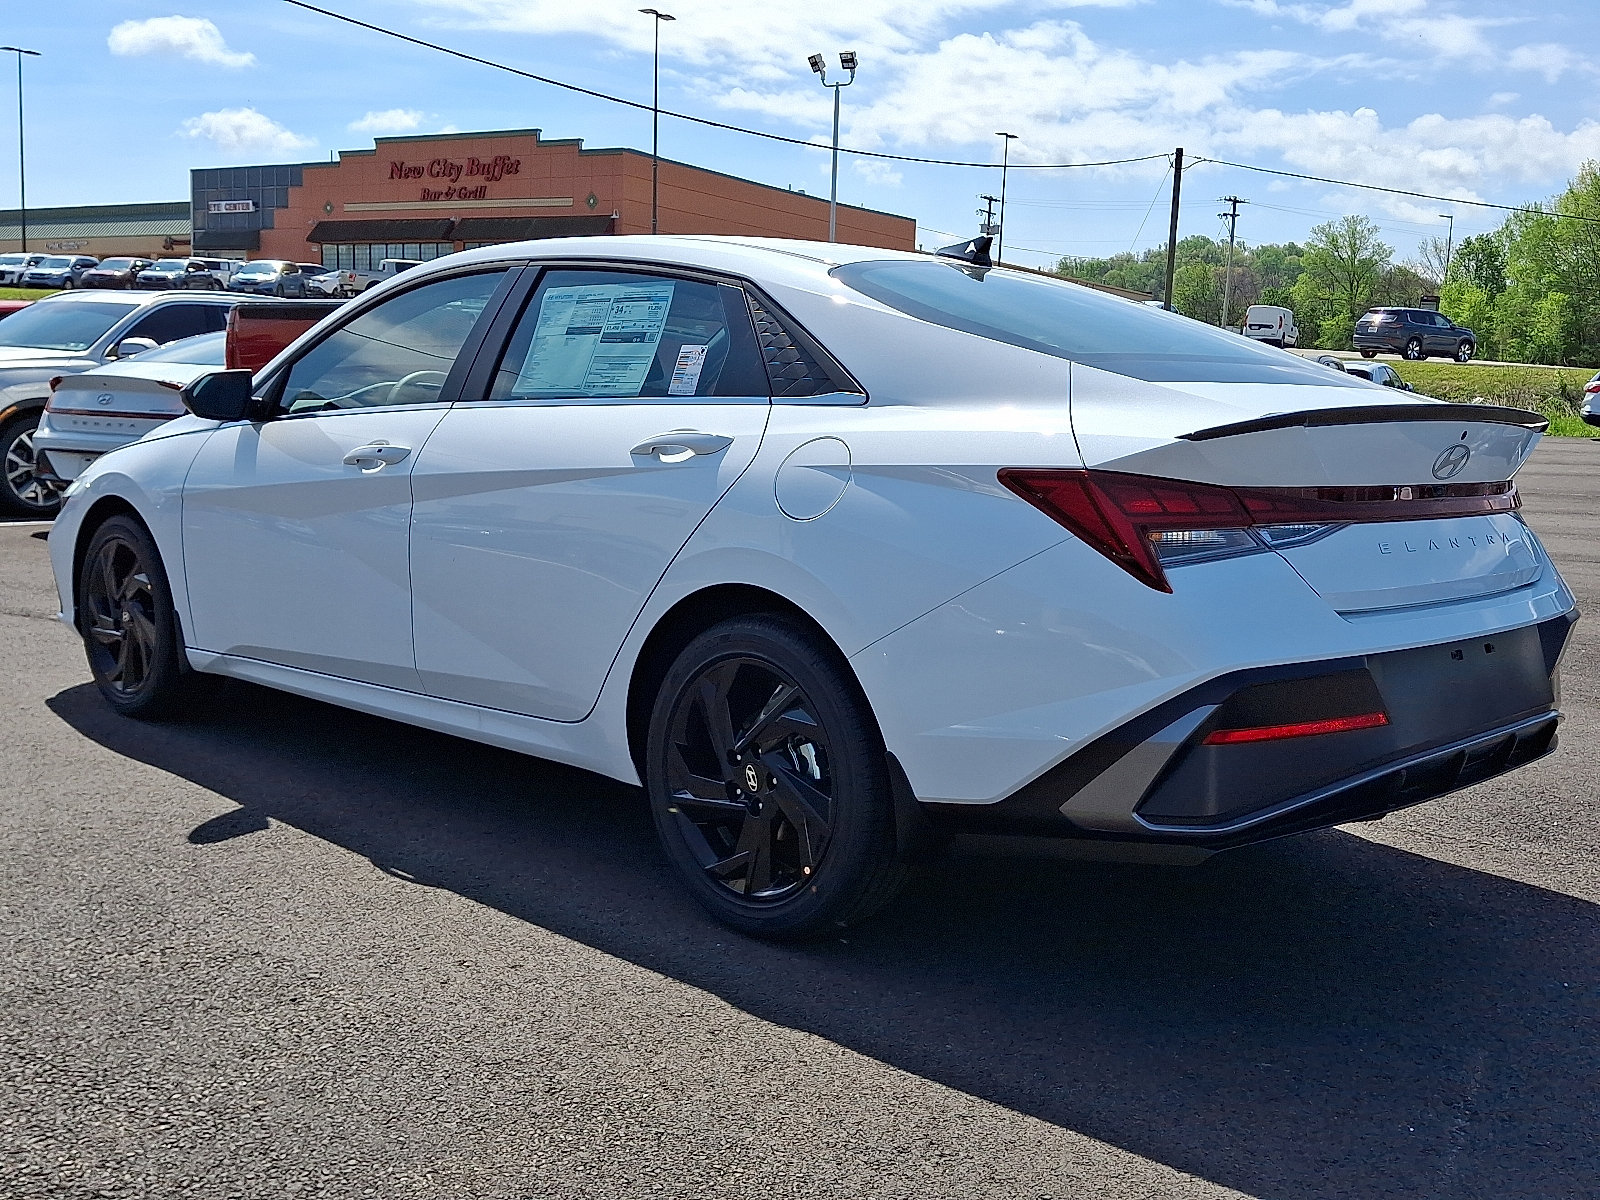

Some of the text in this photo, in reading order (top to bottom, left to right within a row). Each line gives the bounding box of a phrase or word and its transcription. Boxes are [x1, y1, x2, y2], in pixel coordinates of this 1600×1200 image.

[388, 155, 522, 183] New City Buffet
[420, 187, 443, 200] Bar
[458, 186, 488, 199] Grill
[614, 305, 624, 314] 34
[1378, 532, 1511, 555] ELANTRA
